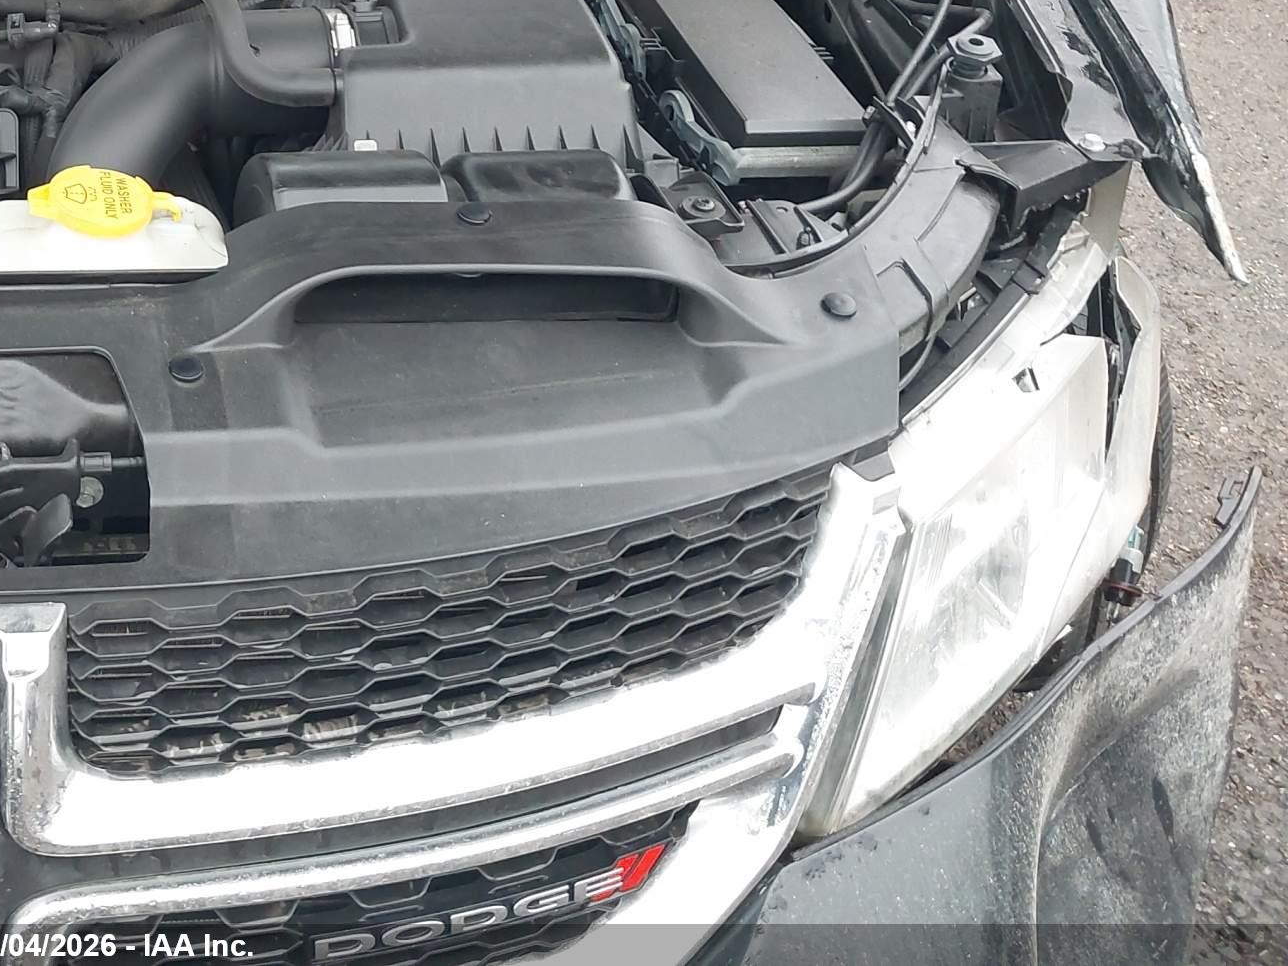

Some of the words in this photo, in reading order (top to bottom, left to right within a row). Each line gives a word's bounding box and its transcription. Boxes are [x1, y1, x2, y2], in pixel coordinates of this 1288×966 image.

[99, 171, 114, 195] FLUID
[116, 177, 132, 214] WASHER
[104, 196, 119, 220] ONLY
[314, 867, 624, 961] DODGE
